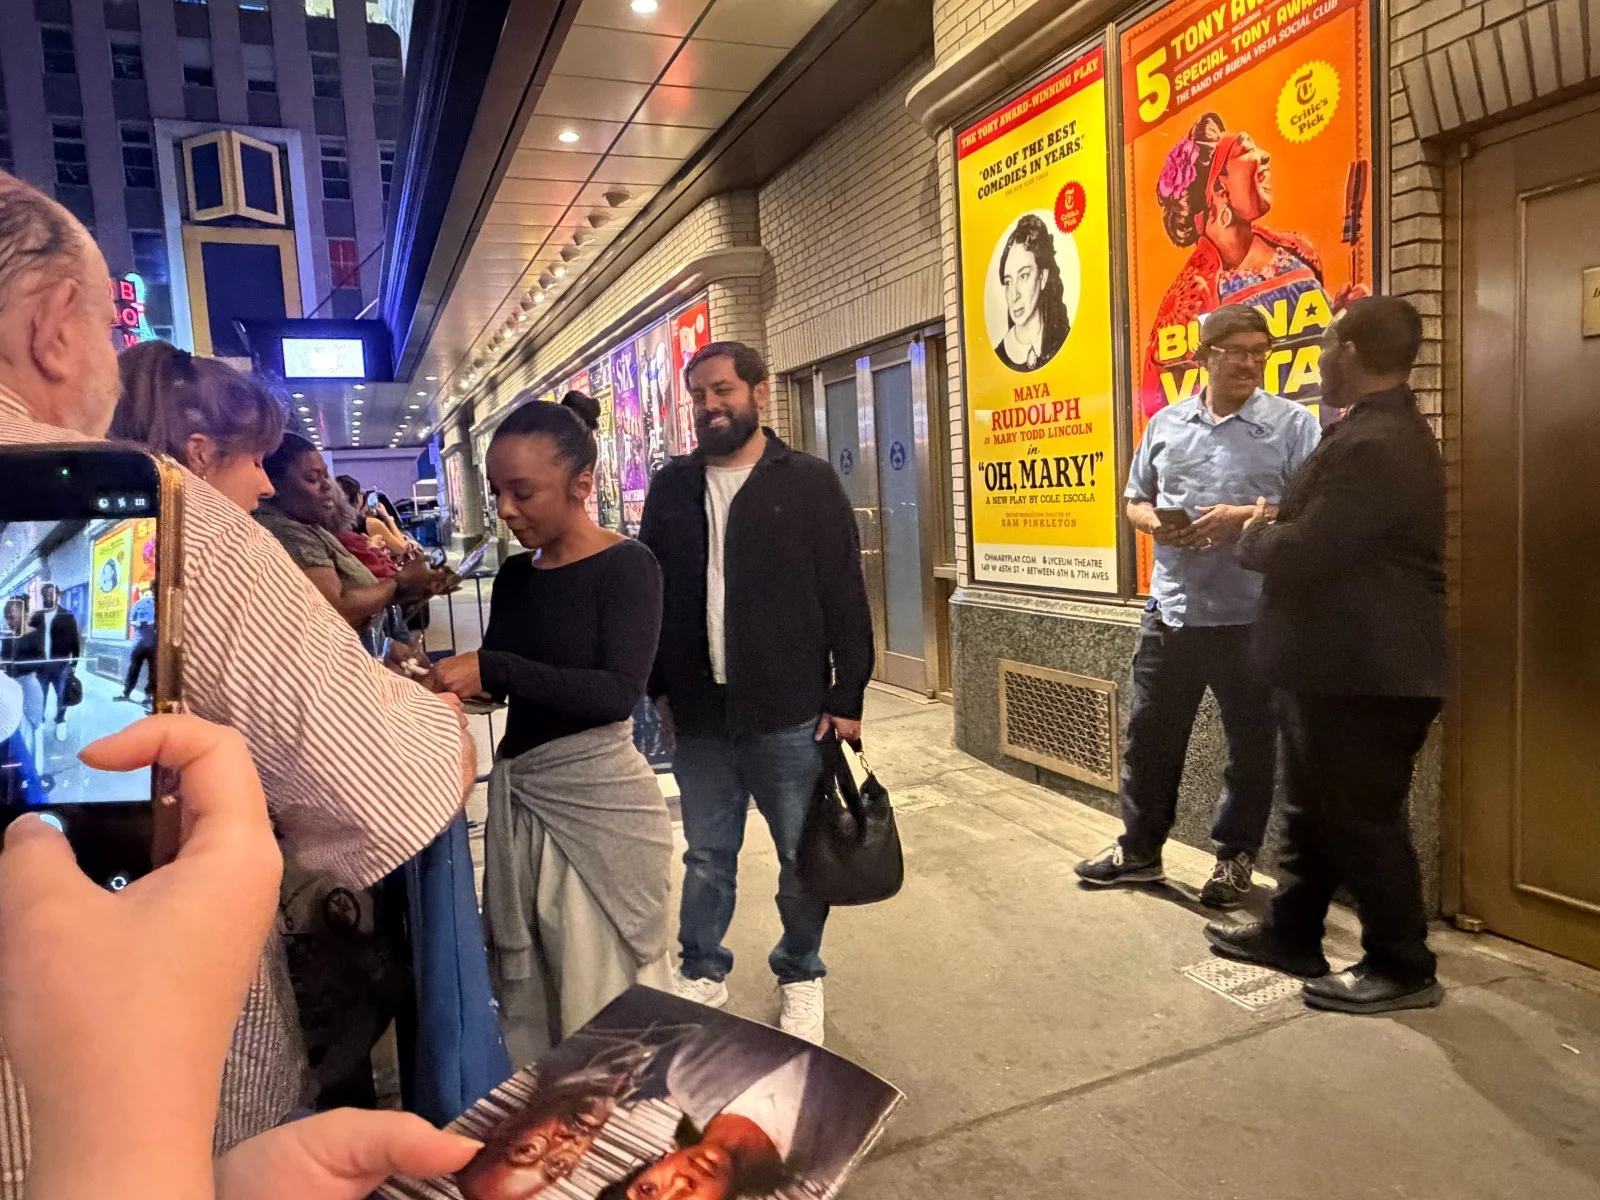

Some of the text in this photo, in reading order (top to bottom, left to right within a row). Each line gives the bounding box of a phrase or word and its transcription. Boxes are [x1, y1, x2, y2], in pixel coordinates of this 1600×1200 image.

[1170, 3, 1227, 60] TONY
[1231, 9, 1262, 35] INCLUDING
[1174, 47, 1228, 91] SPECIAL
[1231, 14, 1272, 54] TONY
[1176, 0, 1338, 106] THE BAND OF BUENA VISTA SOCIAL CLUB
[1136, 46, 1171, 123] 5
[961, 57, 1100, 149] THE TONY AWARD-WINNING PLAY
[1290, 97, 1328, 126] Critic's
[1298, 113, 1325, 136] Pick
[1005, 151, 1019, 169] OF
[1021, 137, 1044, 161] THE
[1046, 120, 1077, 148] BEST
[977, 164, 1027, 200] COMEDIES
[1029, 157, 1042, 175] IN
[1013, 382, 1051, 402] MAYA
[991, 397, 1081, 431] RUDOLPH
[993, 432, 1017, 445] MARY
[1019, 429, 1045, 441] TODD
[1047, 423, 1093, 438] LINCOLN
[1026, 444, 1040, 456] in
[985, 493, 1096, 505] A NEW PLAY BY COLE ESCOLA
[1001, 518, 1077, 528] SAM PINKLETON
[1013, 565, 1020, 573] ST
[1027, 566, 1055, 577] BETWEEN
[1056, 568, 1069, 577] 6TH
[1076, 569, 1090, 579] 7TH
[1091, 570, 1110, 581] AVES
[1048, 556, 1072, 566] LYCEUM
[1074, 558, 1103, 569] THEATRE
